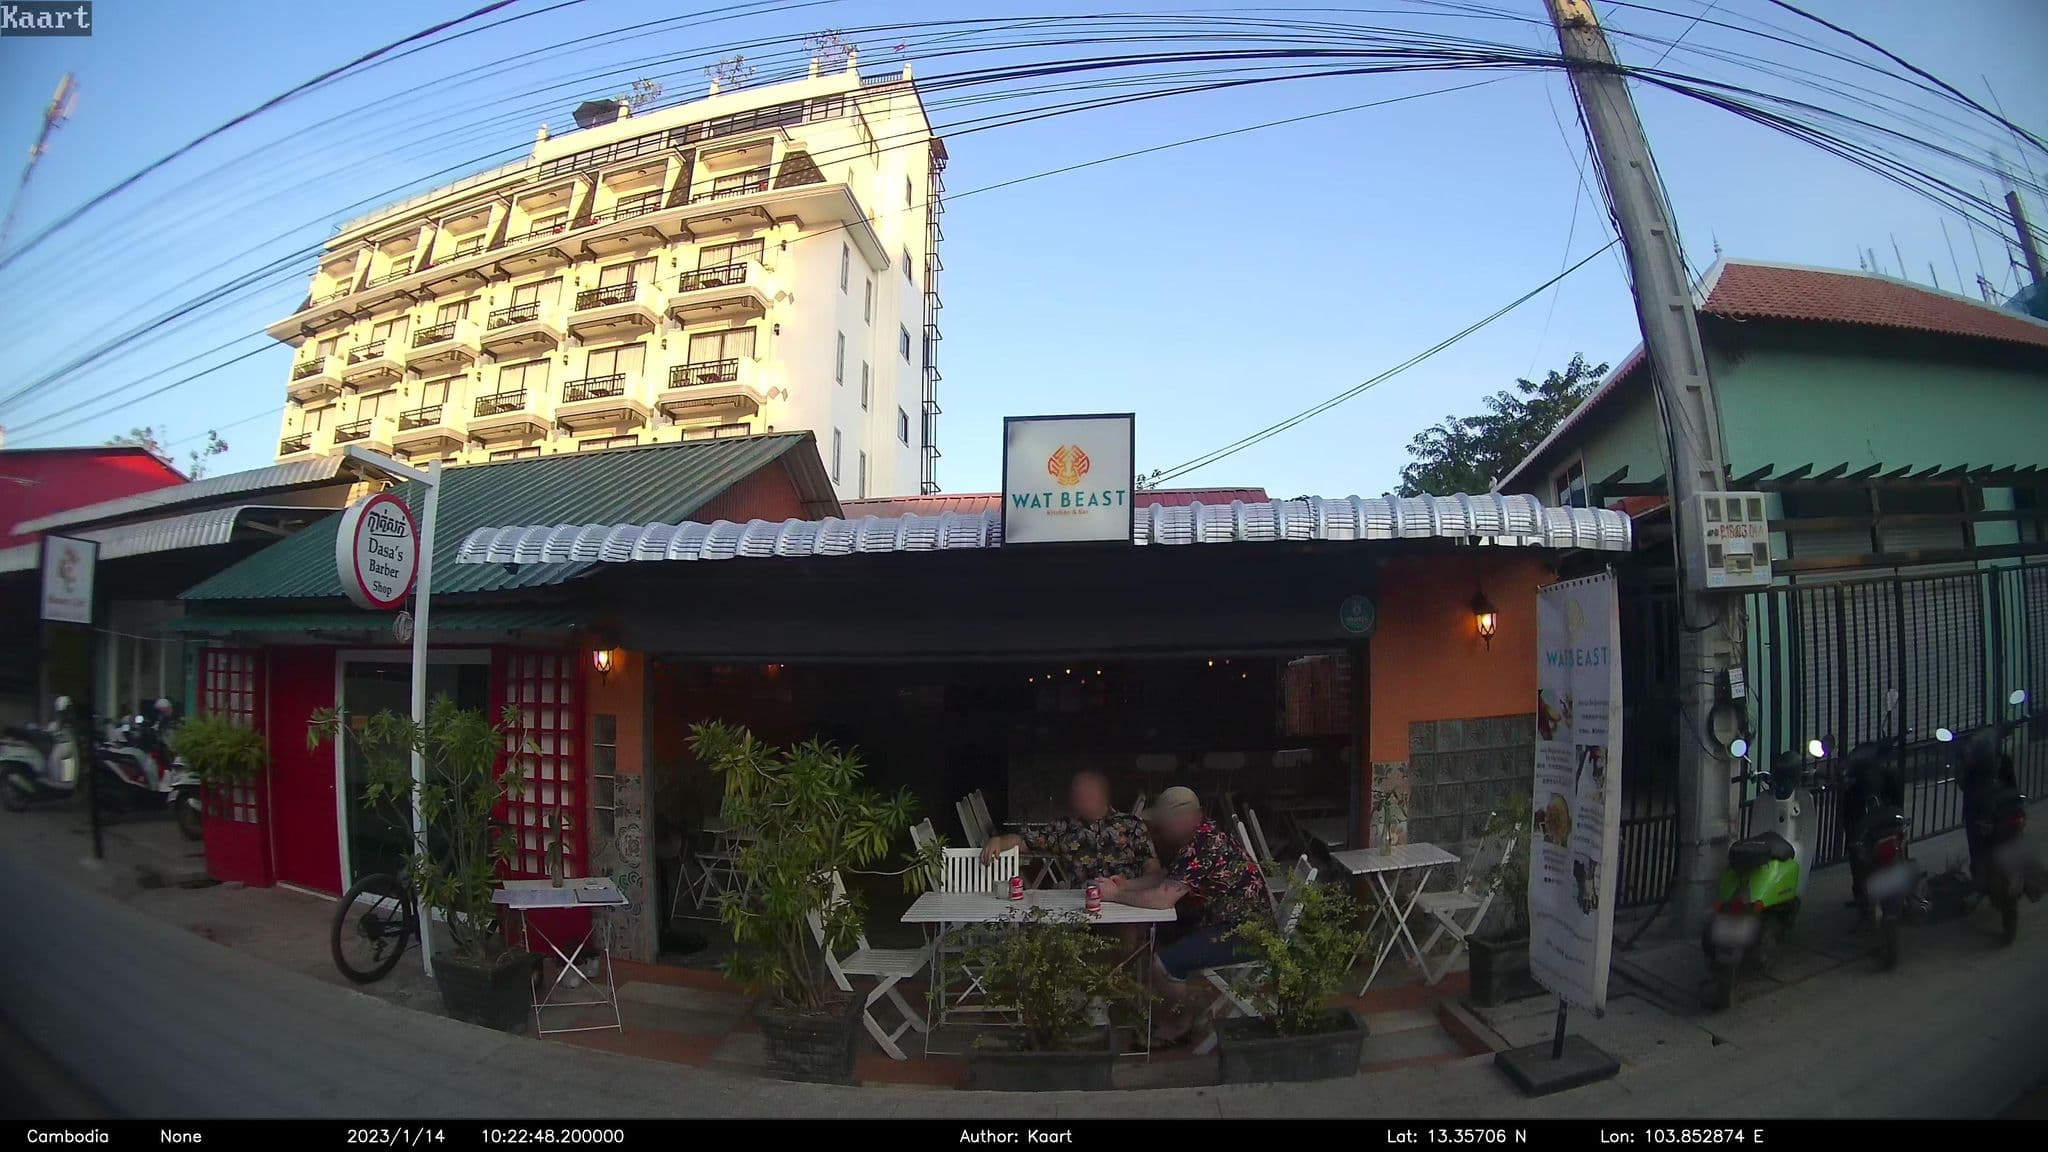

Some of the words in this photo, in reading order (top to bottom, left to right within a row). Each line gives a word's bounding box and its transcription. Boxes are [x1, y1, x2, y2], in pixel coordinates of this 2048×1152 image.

[1012, 492, 1053, 509] WAT
[1060, 490, 1126, 508] BEAST
[368, 537, 404, 562] Dasa's
[369, 559, 400, 579] Barber
[372, 580, 392, 597] Shop
